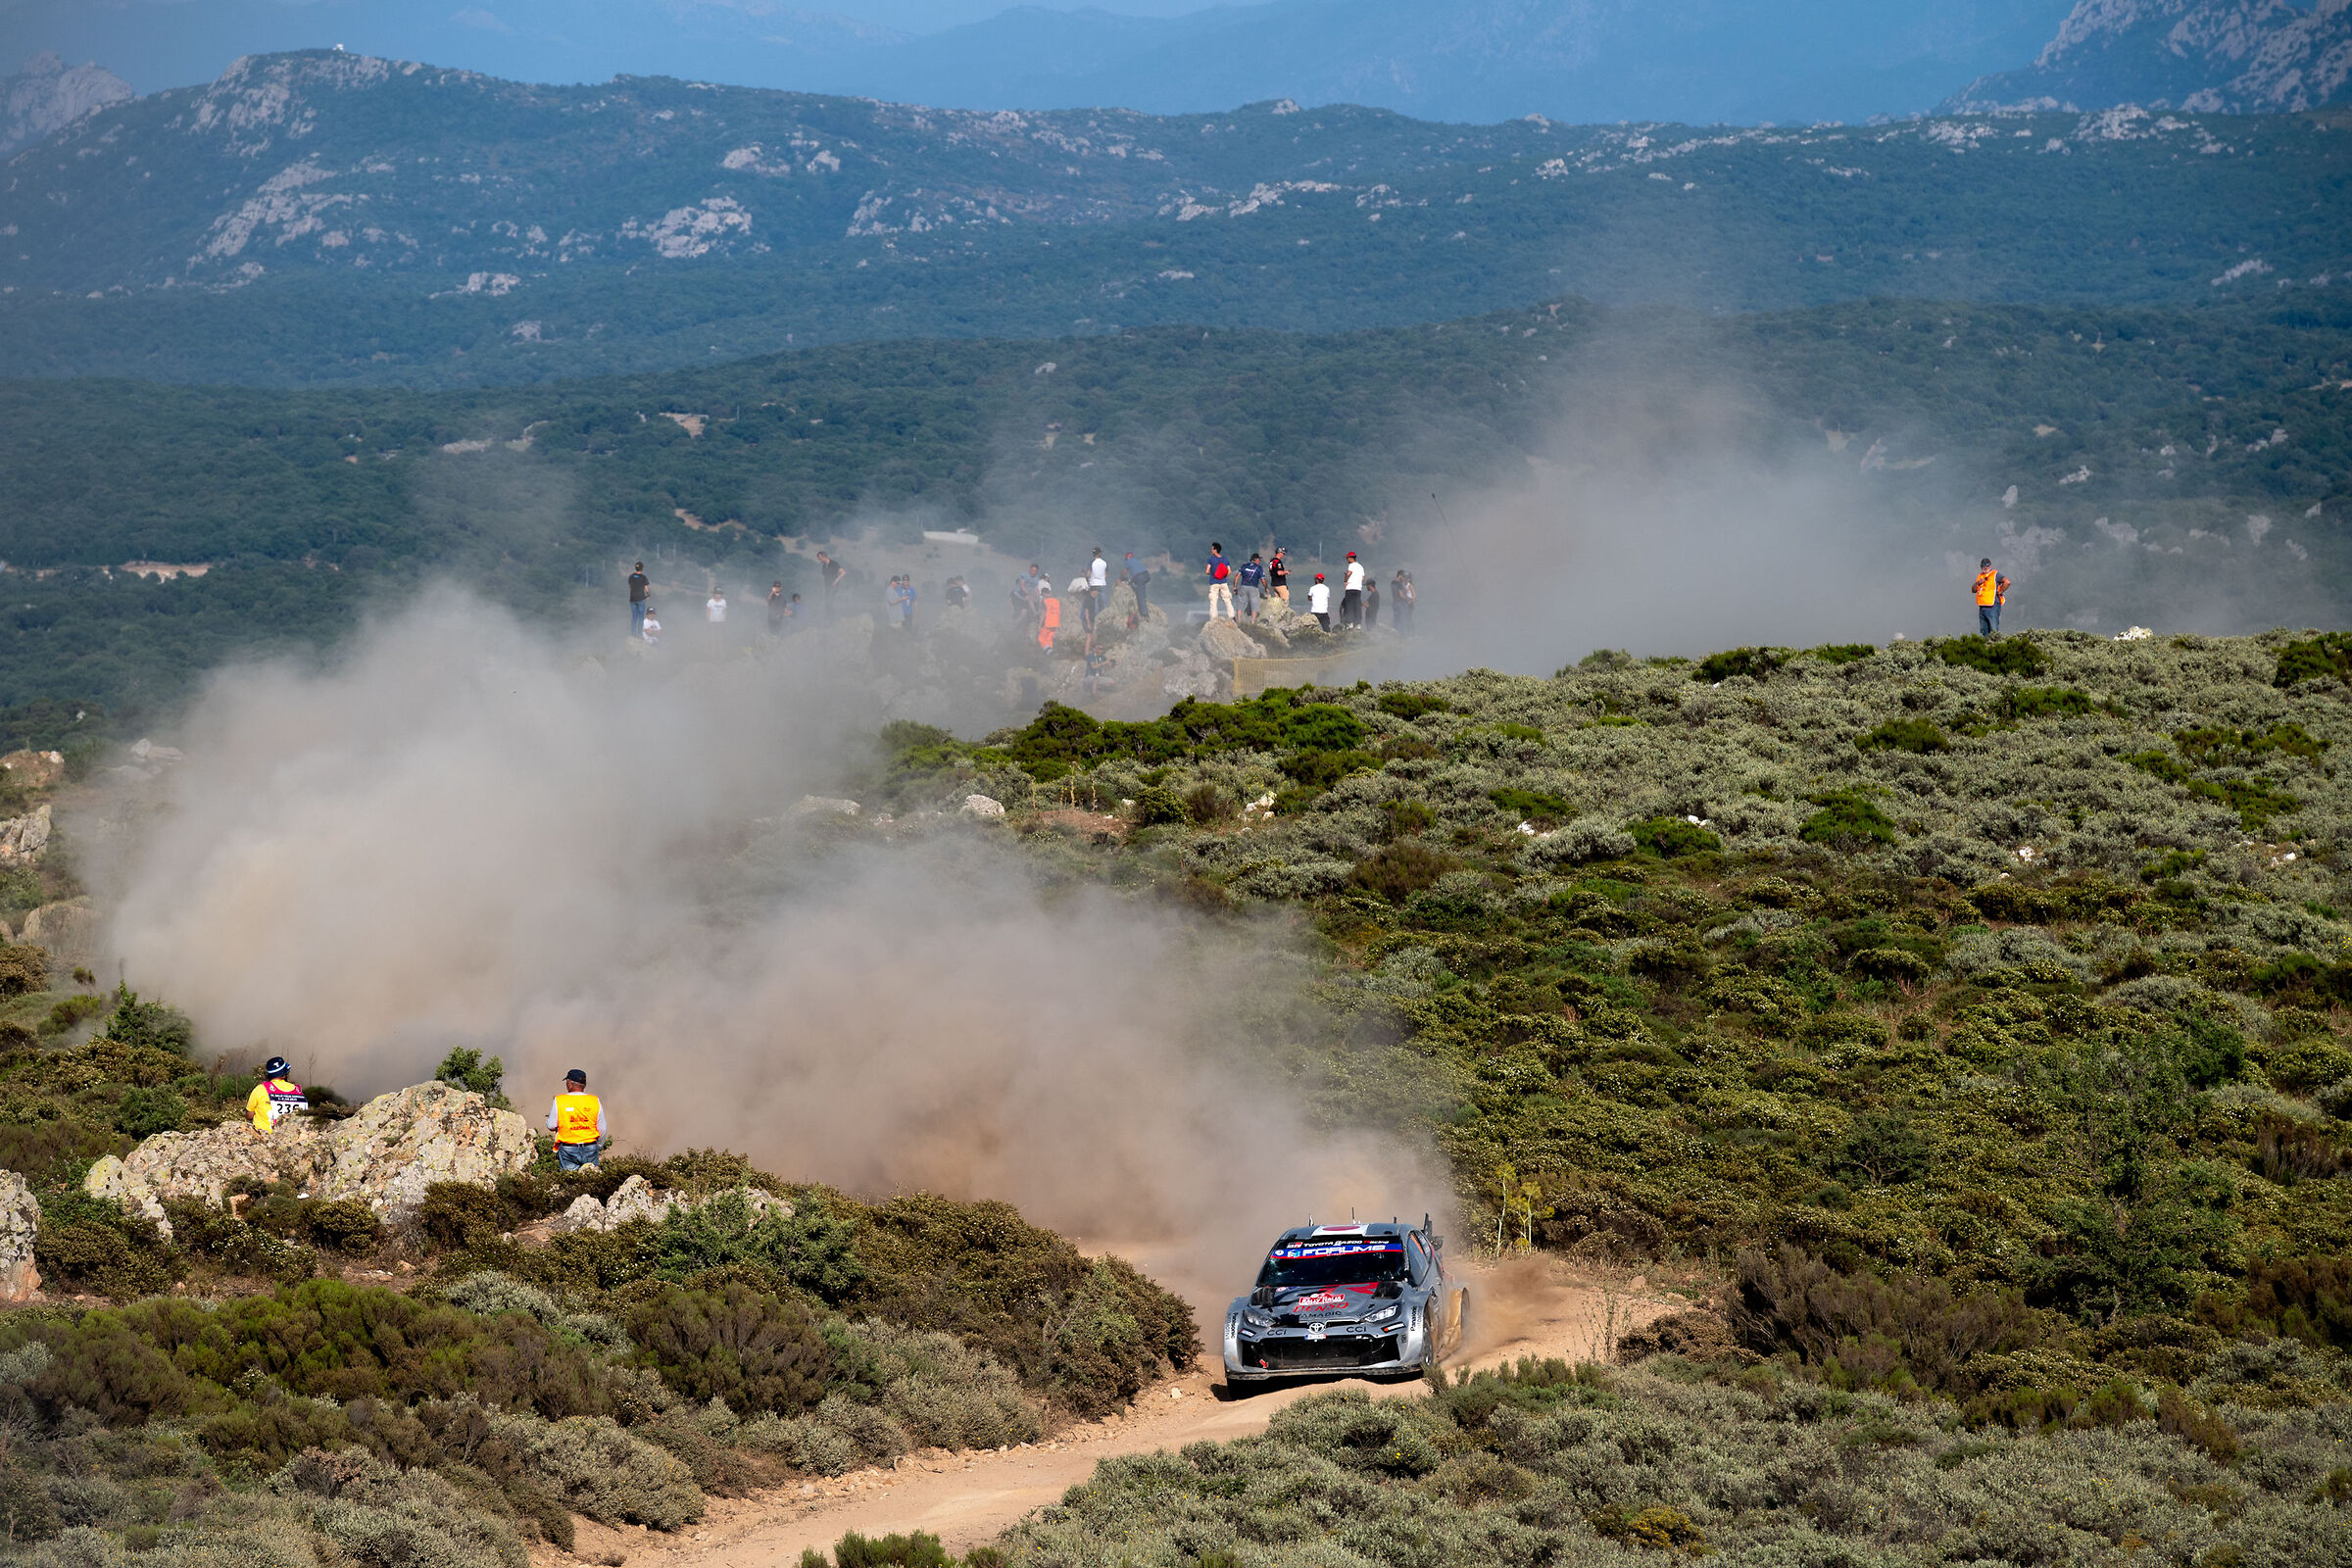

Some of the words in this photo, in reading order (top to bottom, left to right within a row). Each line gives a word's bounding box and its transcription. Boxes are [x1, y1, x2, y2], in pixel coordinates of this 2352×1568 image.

[1302, 1245, 1386, 1256] FORUM8
[1301, 1296, 1322, 1305] RALLY
[1293, 1301, 1349, 1312] DENSO
